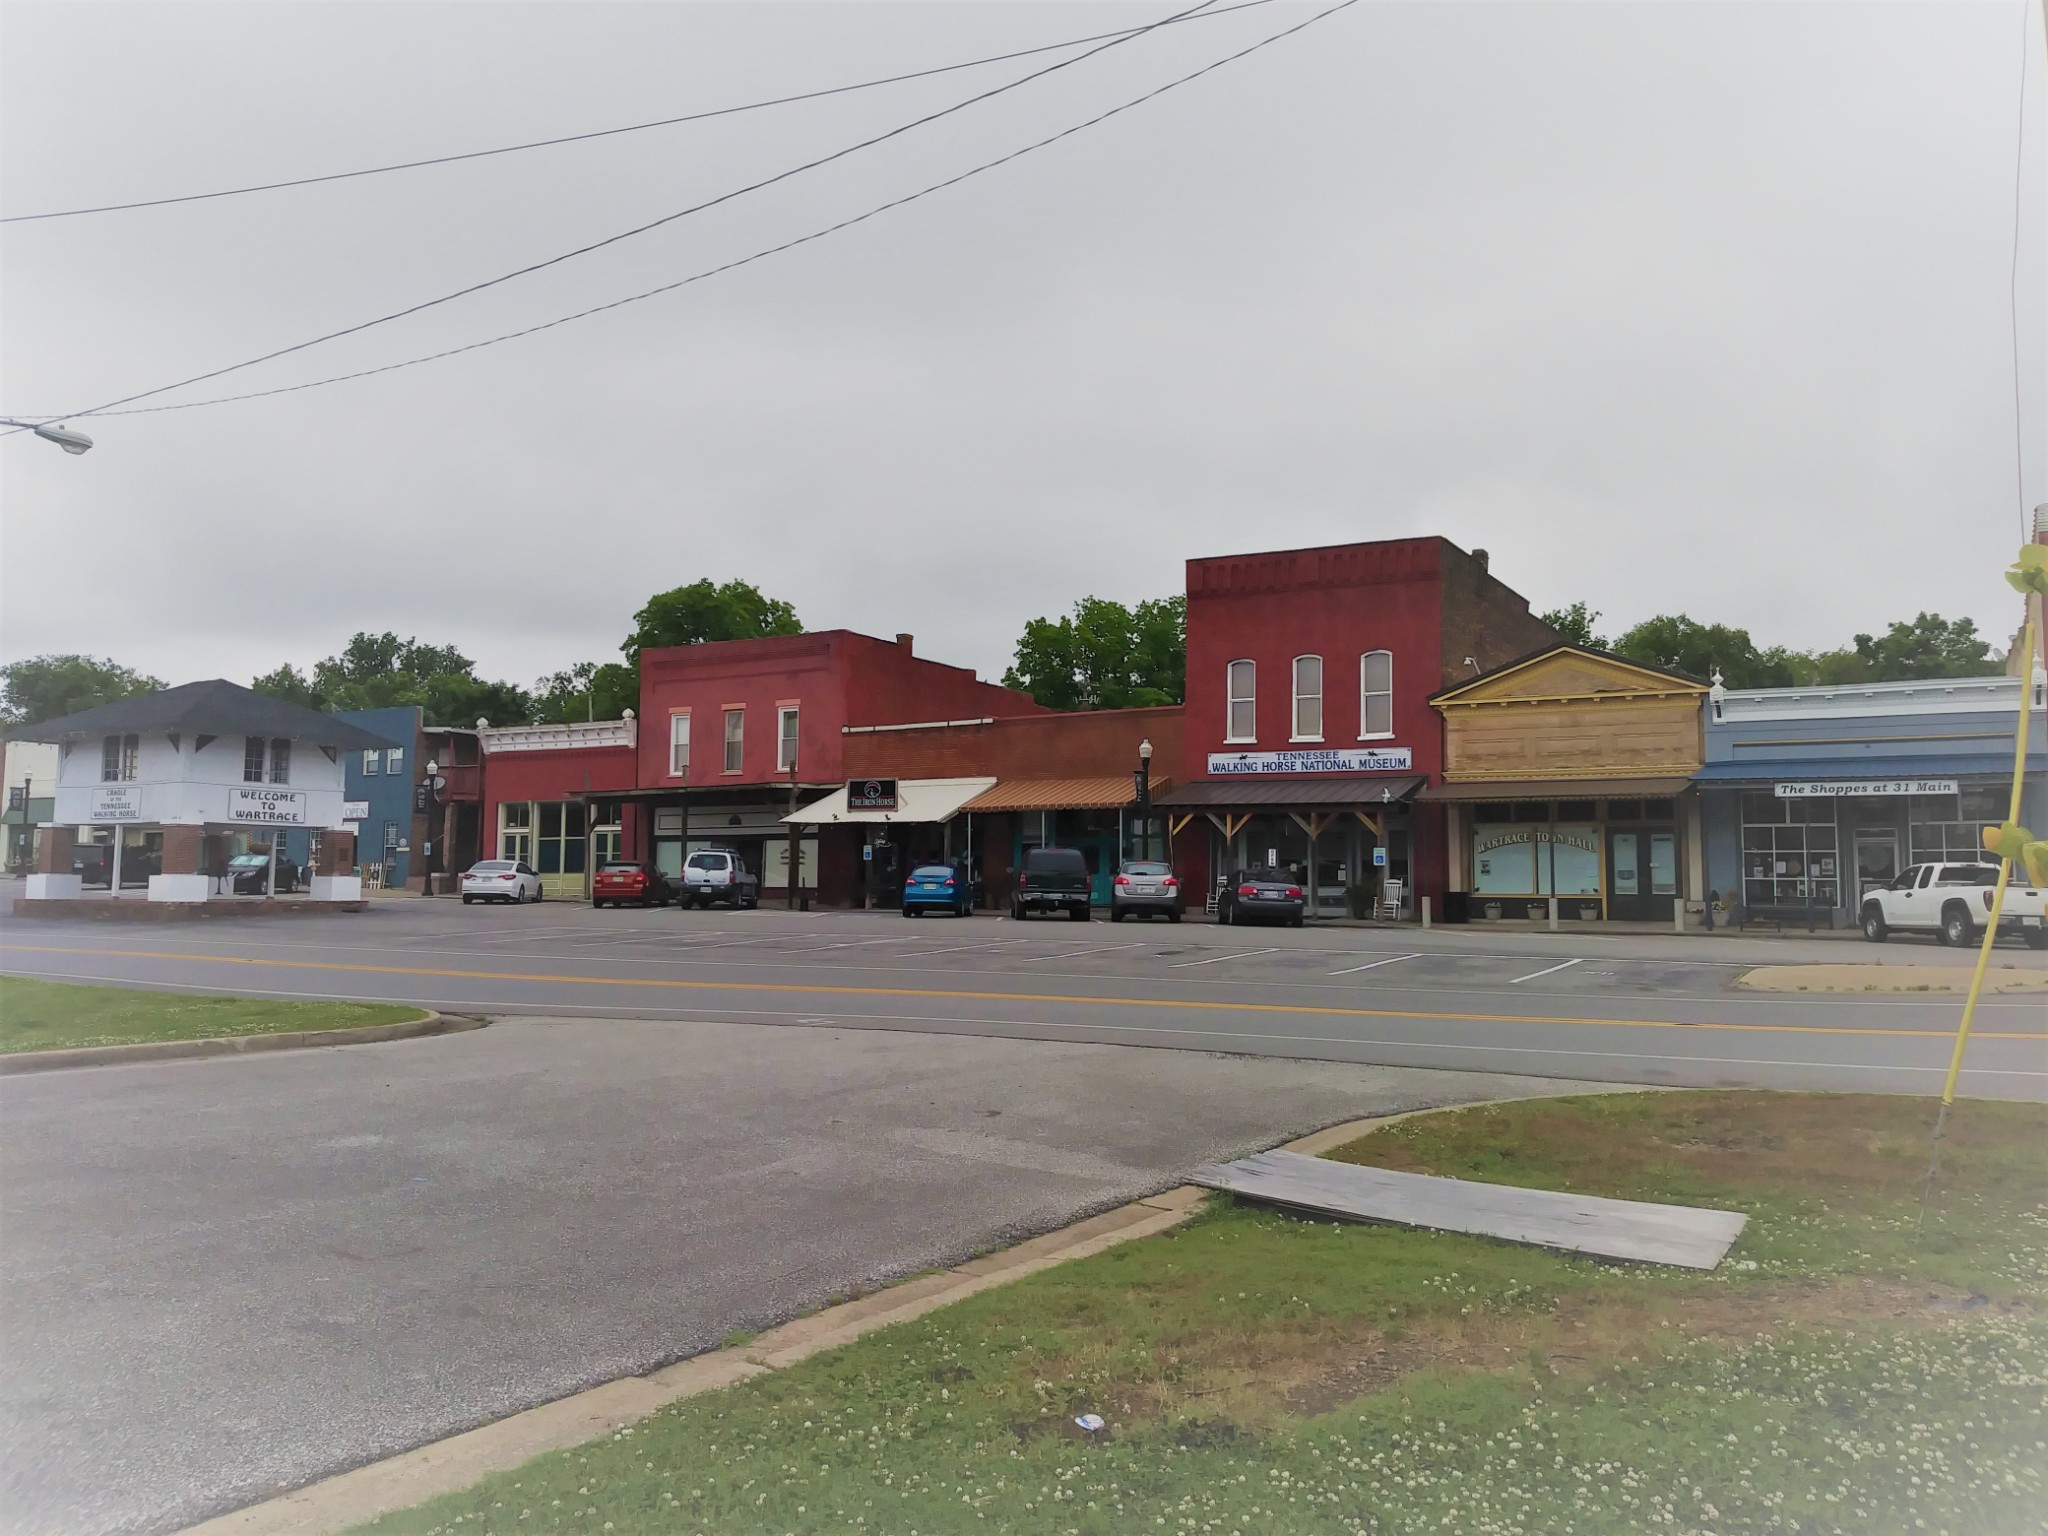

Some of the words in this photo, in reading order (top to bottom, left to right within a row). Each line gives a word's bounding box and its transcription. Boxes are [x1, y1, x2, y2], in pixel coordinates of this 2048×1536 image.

[1275, 751, 1340, 761] TENNESSEE
[1212, 762, 1258, 772] WALKING
[1261, 761, 1297, 771] HORSE
[1301, 760, 1355, 771] NATIONAL
[1359, 758, 1407, 769] MUSEUM
[1780, 785, 1805, 794] The
[1810, 784, 1868, 795] Shoppes
[1873, 784, 1888, 792] at
[1893, 783, 1910, 792] 31
[1916, 782, 1952, 792] Main
[240, 790, 296, 802] WELCOME
[261, 802, 276, 810] TO
[235, 810, 298, 821] WARTRACE
[345, 807, 367, 817] OPEN
[1477, 832, 1530, 853] WARTRACE
[1568, 836, 1596, 853] HALL
